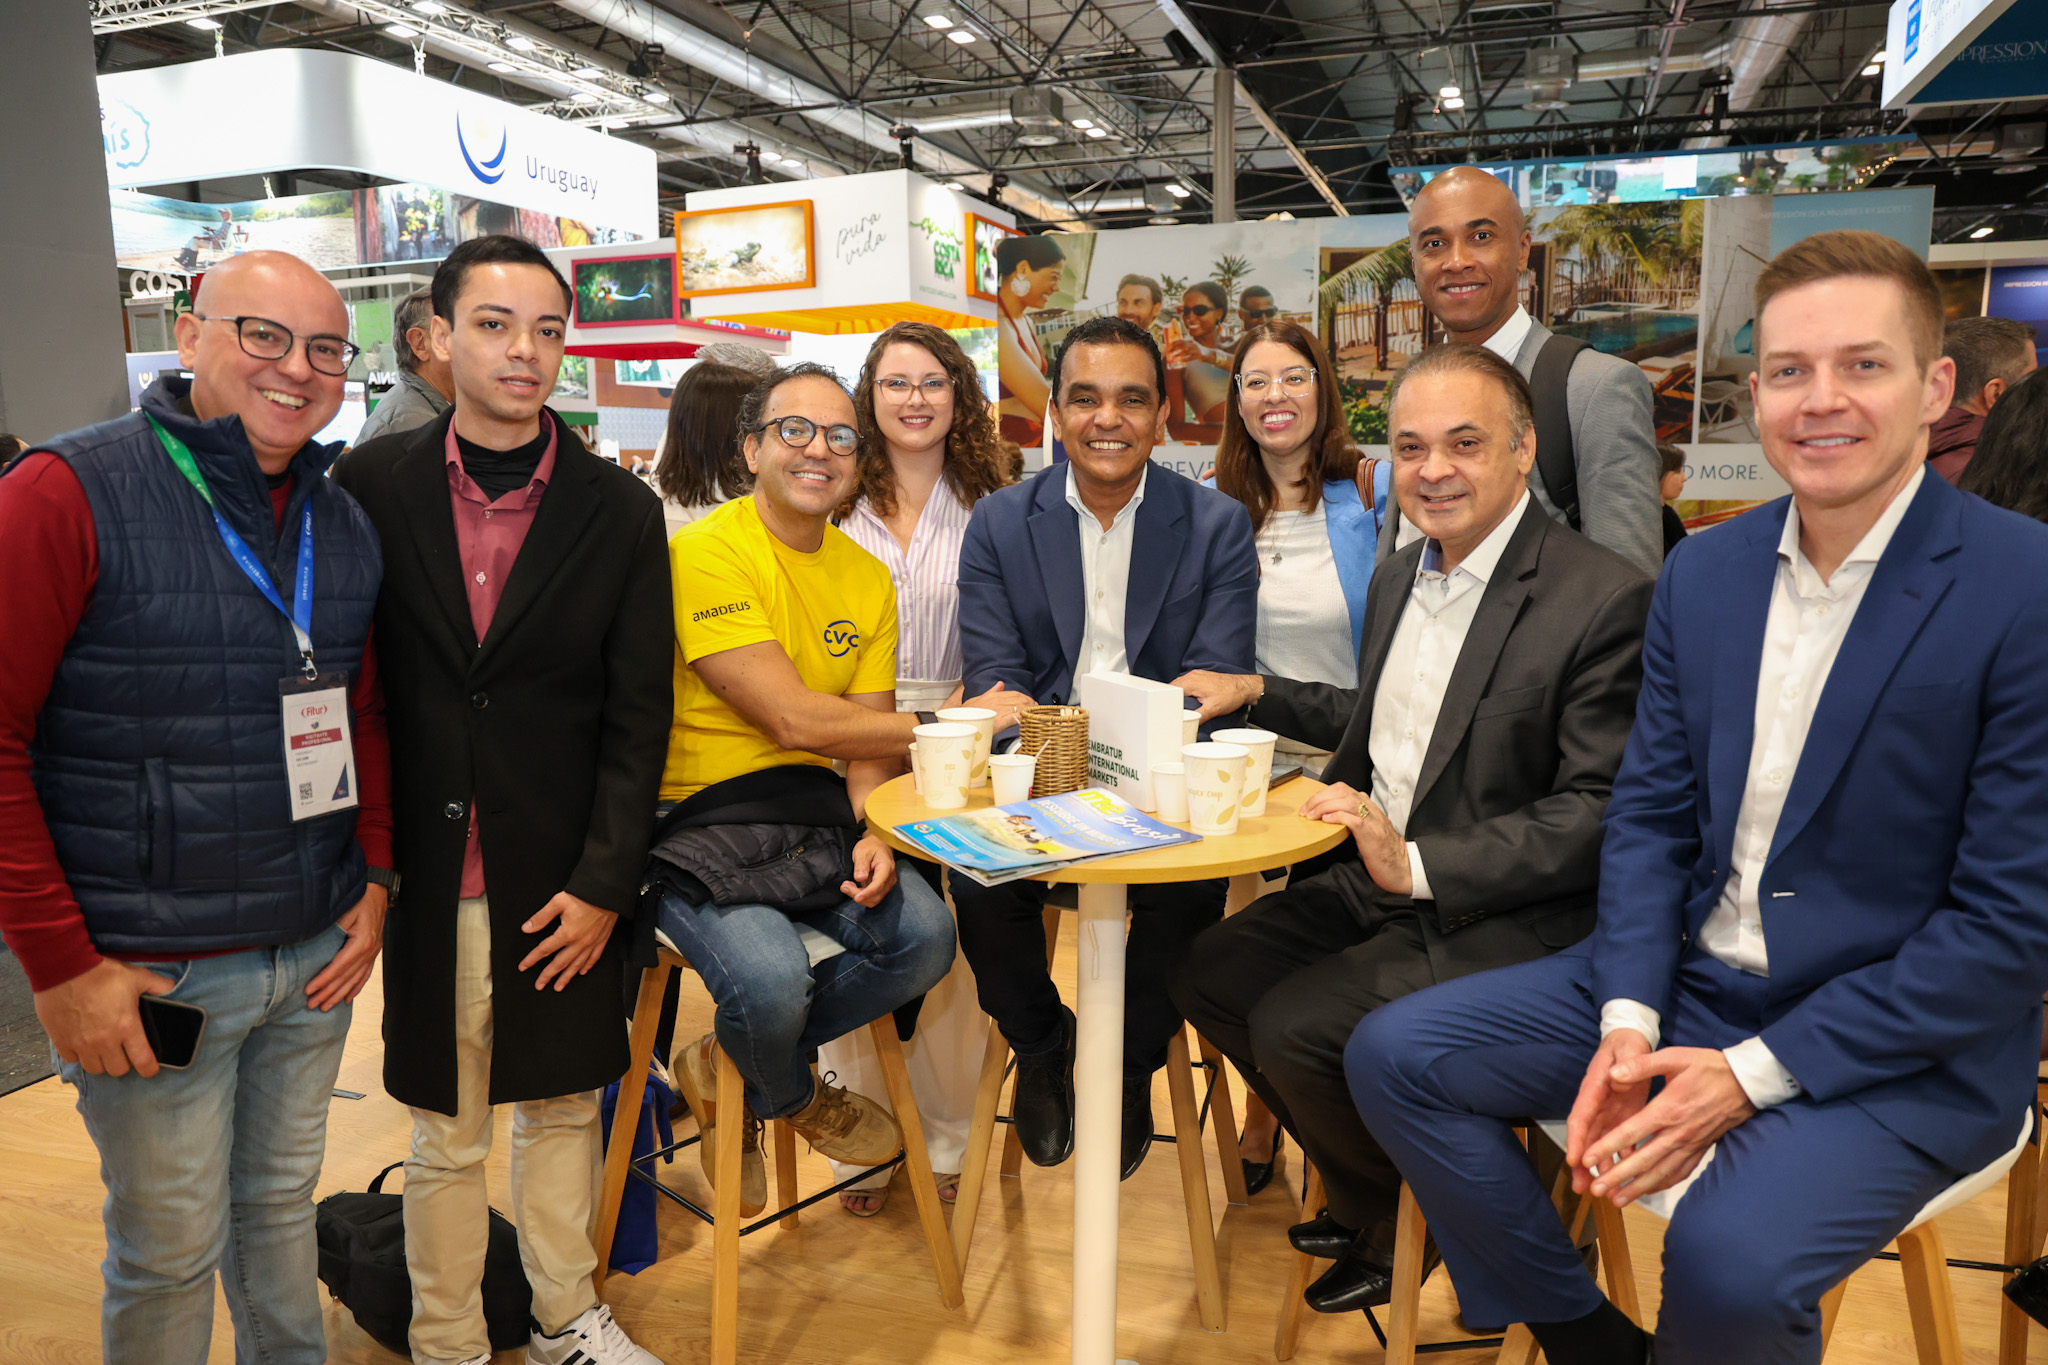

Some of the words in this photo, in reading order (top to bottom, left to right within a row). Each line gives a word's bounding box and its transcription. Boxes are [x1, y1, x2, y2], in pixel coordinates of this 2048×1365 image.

[526, 155, 598, 200] Uruguay
[836, 212, 881, 259] pura
[846, 229, 887, 265] vida
[1700, 464, 1764, 480] MORE.
[1088, 753, 1140, 781] NTERNATIONAL
